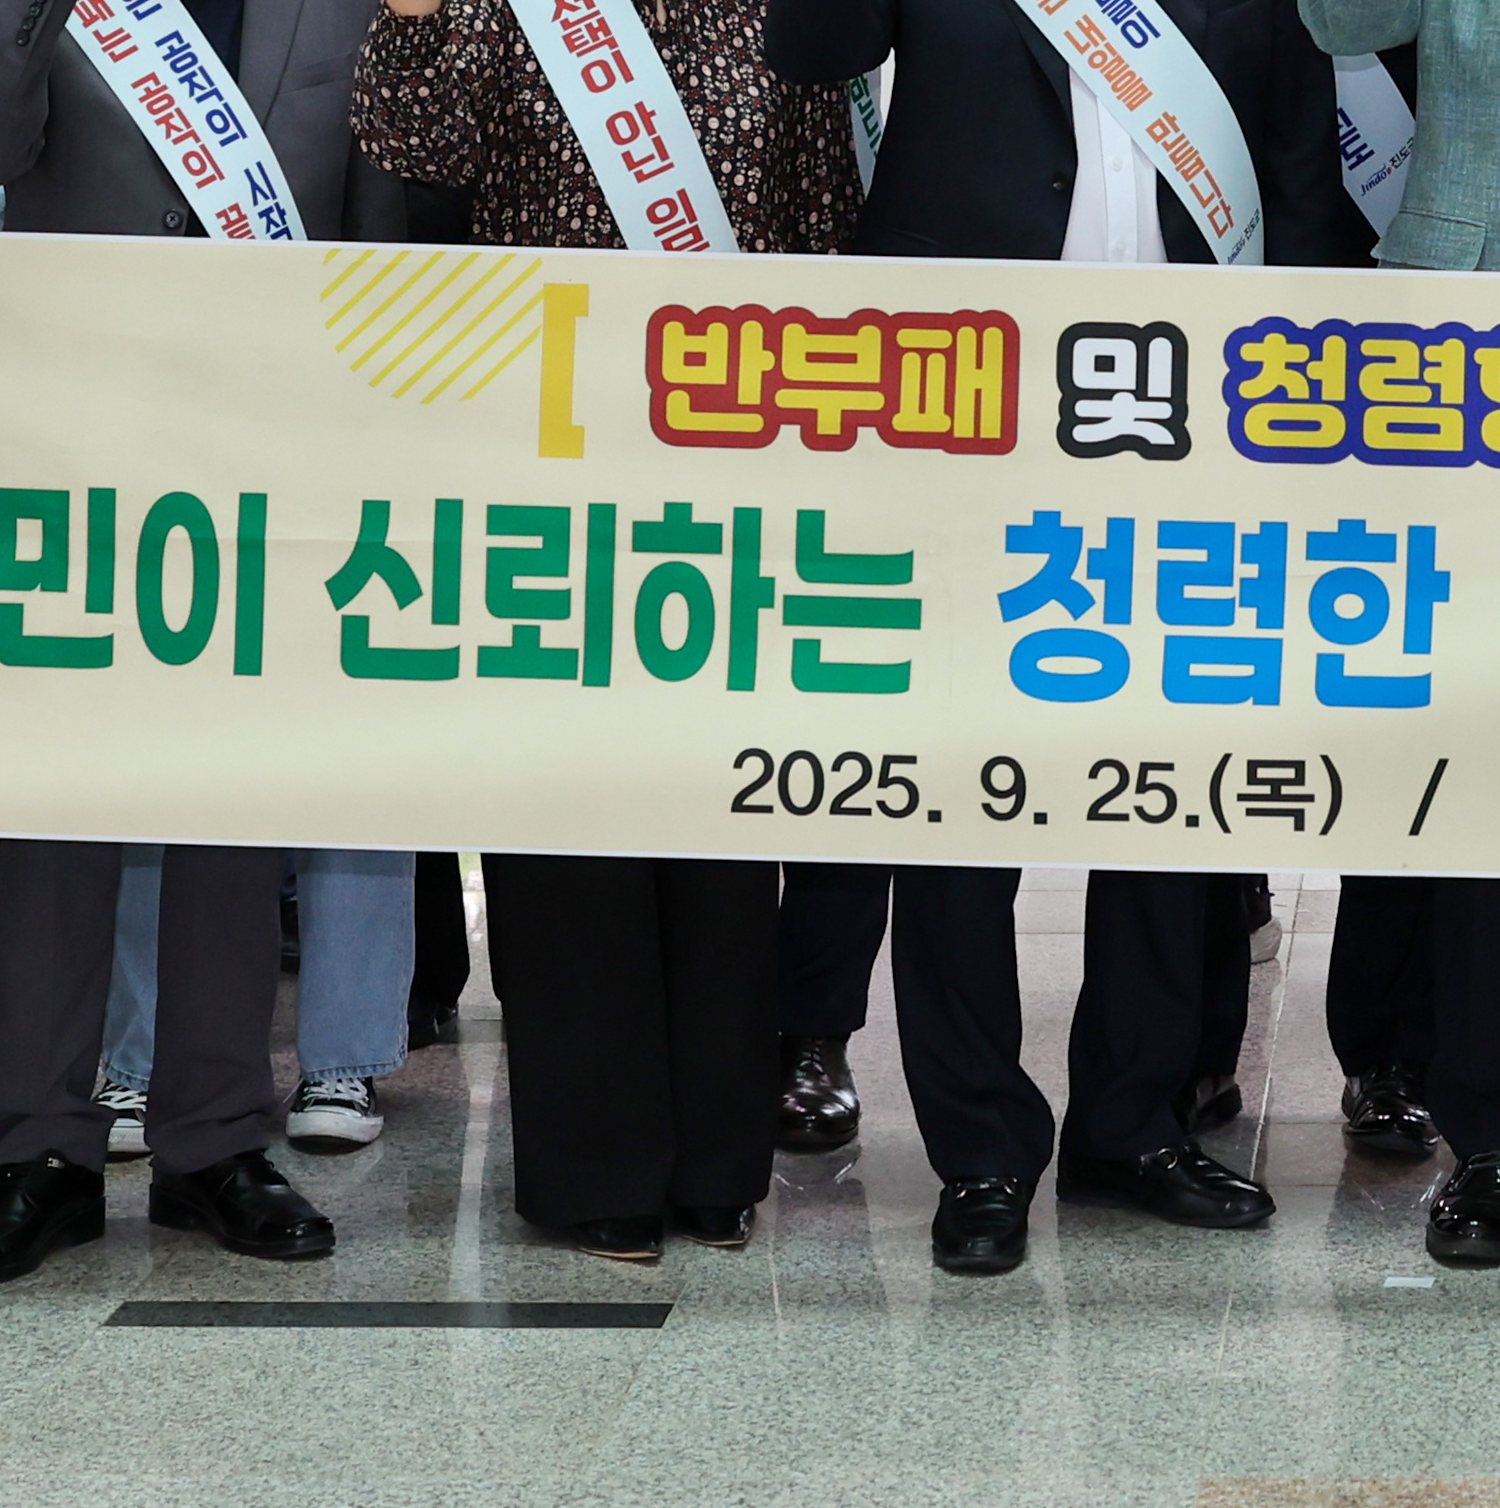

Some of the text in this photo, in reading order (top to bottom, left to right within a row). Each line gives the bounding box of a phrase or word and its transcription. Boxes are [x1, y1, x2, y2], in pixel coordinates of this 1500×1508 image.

[154, 29, 247, 148] 공직의
[650, 307, 1016, 452] 반부패
[1058, 324, 1191, 459] 및
[324, 496, 923, 696] 신뢰하는
[998, 507, 1453, 709] 청렴한
[731, 750, 943, 823] 2025.
[978, 752, 1051, 825] 9.
